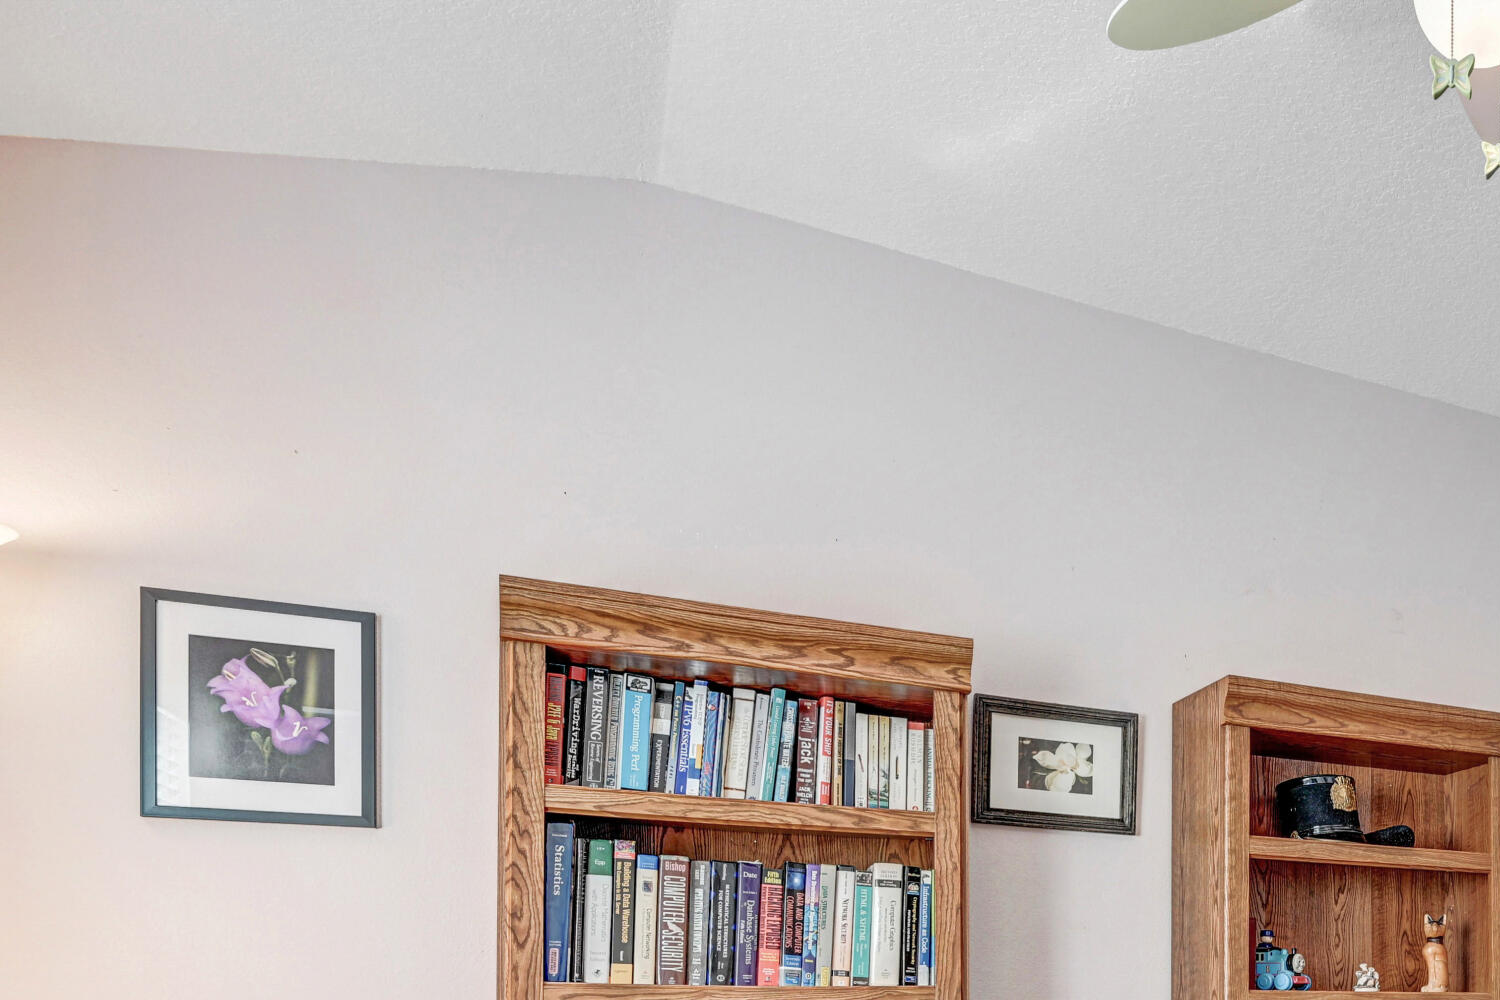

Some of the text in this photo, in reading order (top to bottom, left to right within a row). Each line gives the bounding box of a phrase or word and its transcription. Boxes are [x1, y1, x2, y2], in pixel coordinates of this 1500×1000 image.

[569, 697, 582, 755] WarDriving
[590, 675, 604, 741] REVERSING
[683, 704, 694, 727] IPv6
[823, 700, 834, 756] IT'S YOUR SHIP
[630, 694, 643, 771] Programming Perl
[678, 729, 691, 772] Essentials
[799, 737, 815, 764] jack
[652, 740, 663, 788] EXPERIMENTATION
[554, 844, 565, 896] Statistics
[594, 859, 606, 867] Epp
[620, 862, 632, 886] Building
[664, 861, 687, 873] Bishop
[743, 871, 758, 879] Date
[621, 894, 631, 908] Data
[746, 900, 756, 933] Database
[764, 886, 784, 950] HACKING EXPOSED
[859, 889, 869, 908] HTML
[921, 886, 930, 929] Infrastructure
[621, 909, 630, 944] Warehouse
[661, 875, 687, 973] COMPUTER SECURITY
[722, 885, 731, 959] MATHEMATICAL STRUCTURES
[784, 895, 794, 949] COMMUNICATIONS
[793, 892, 805, 954] DATA AND COMPUTER
[745, 935, 755, 966] Systems
[920, 938, 929, 954] Code
